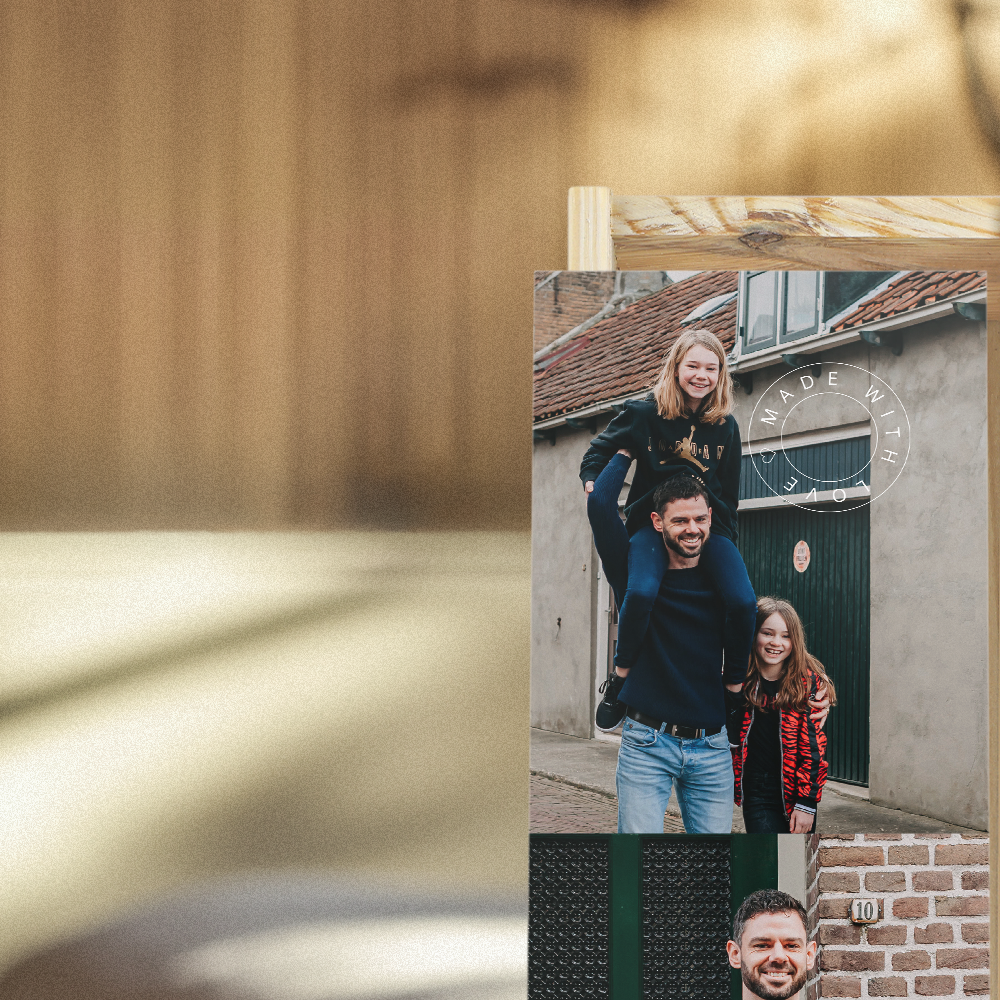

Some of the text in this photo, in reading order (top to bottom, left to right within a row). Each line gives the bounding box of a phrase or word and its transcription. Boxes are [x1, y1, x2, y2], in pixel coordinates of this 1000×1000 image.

[760, 371, 901, 503] MADE WITH LOVE
[856, 901, 874, 920] 10
